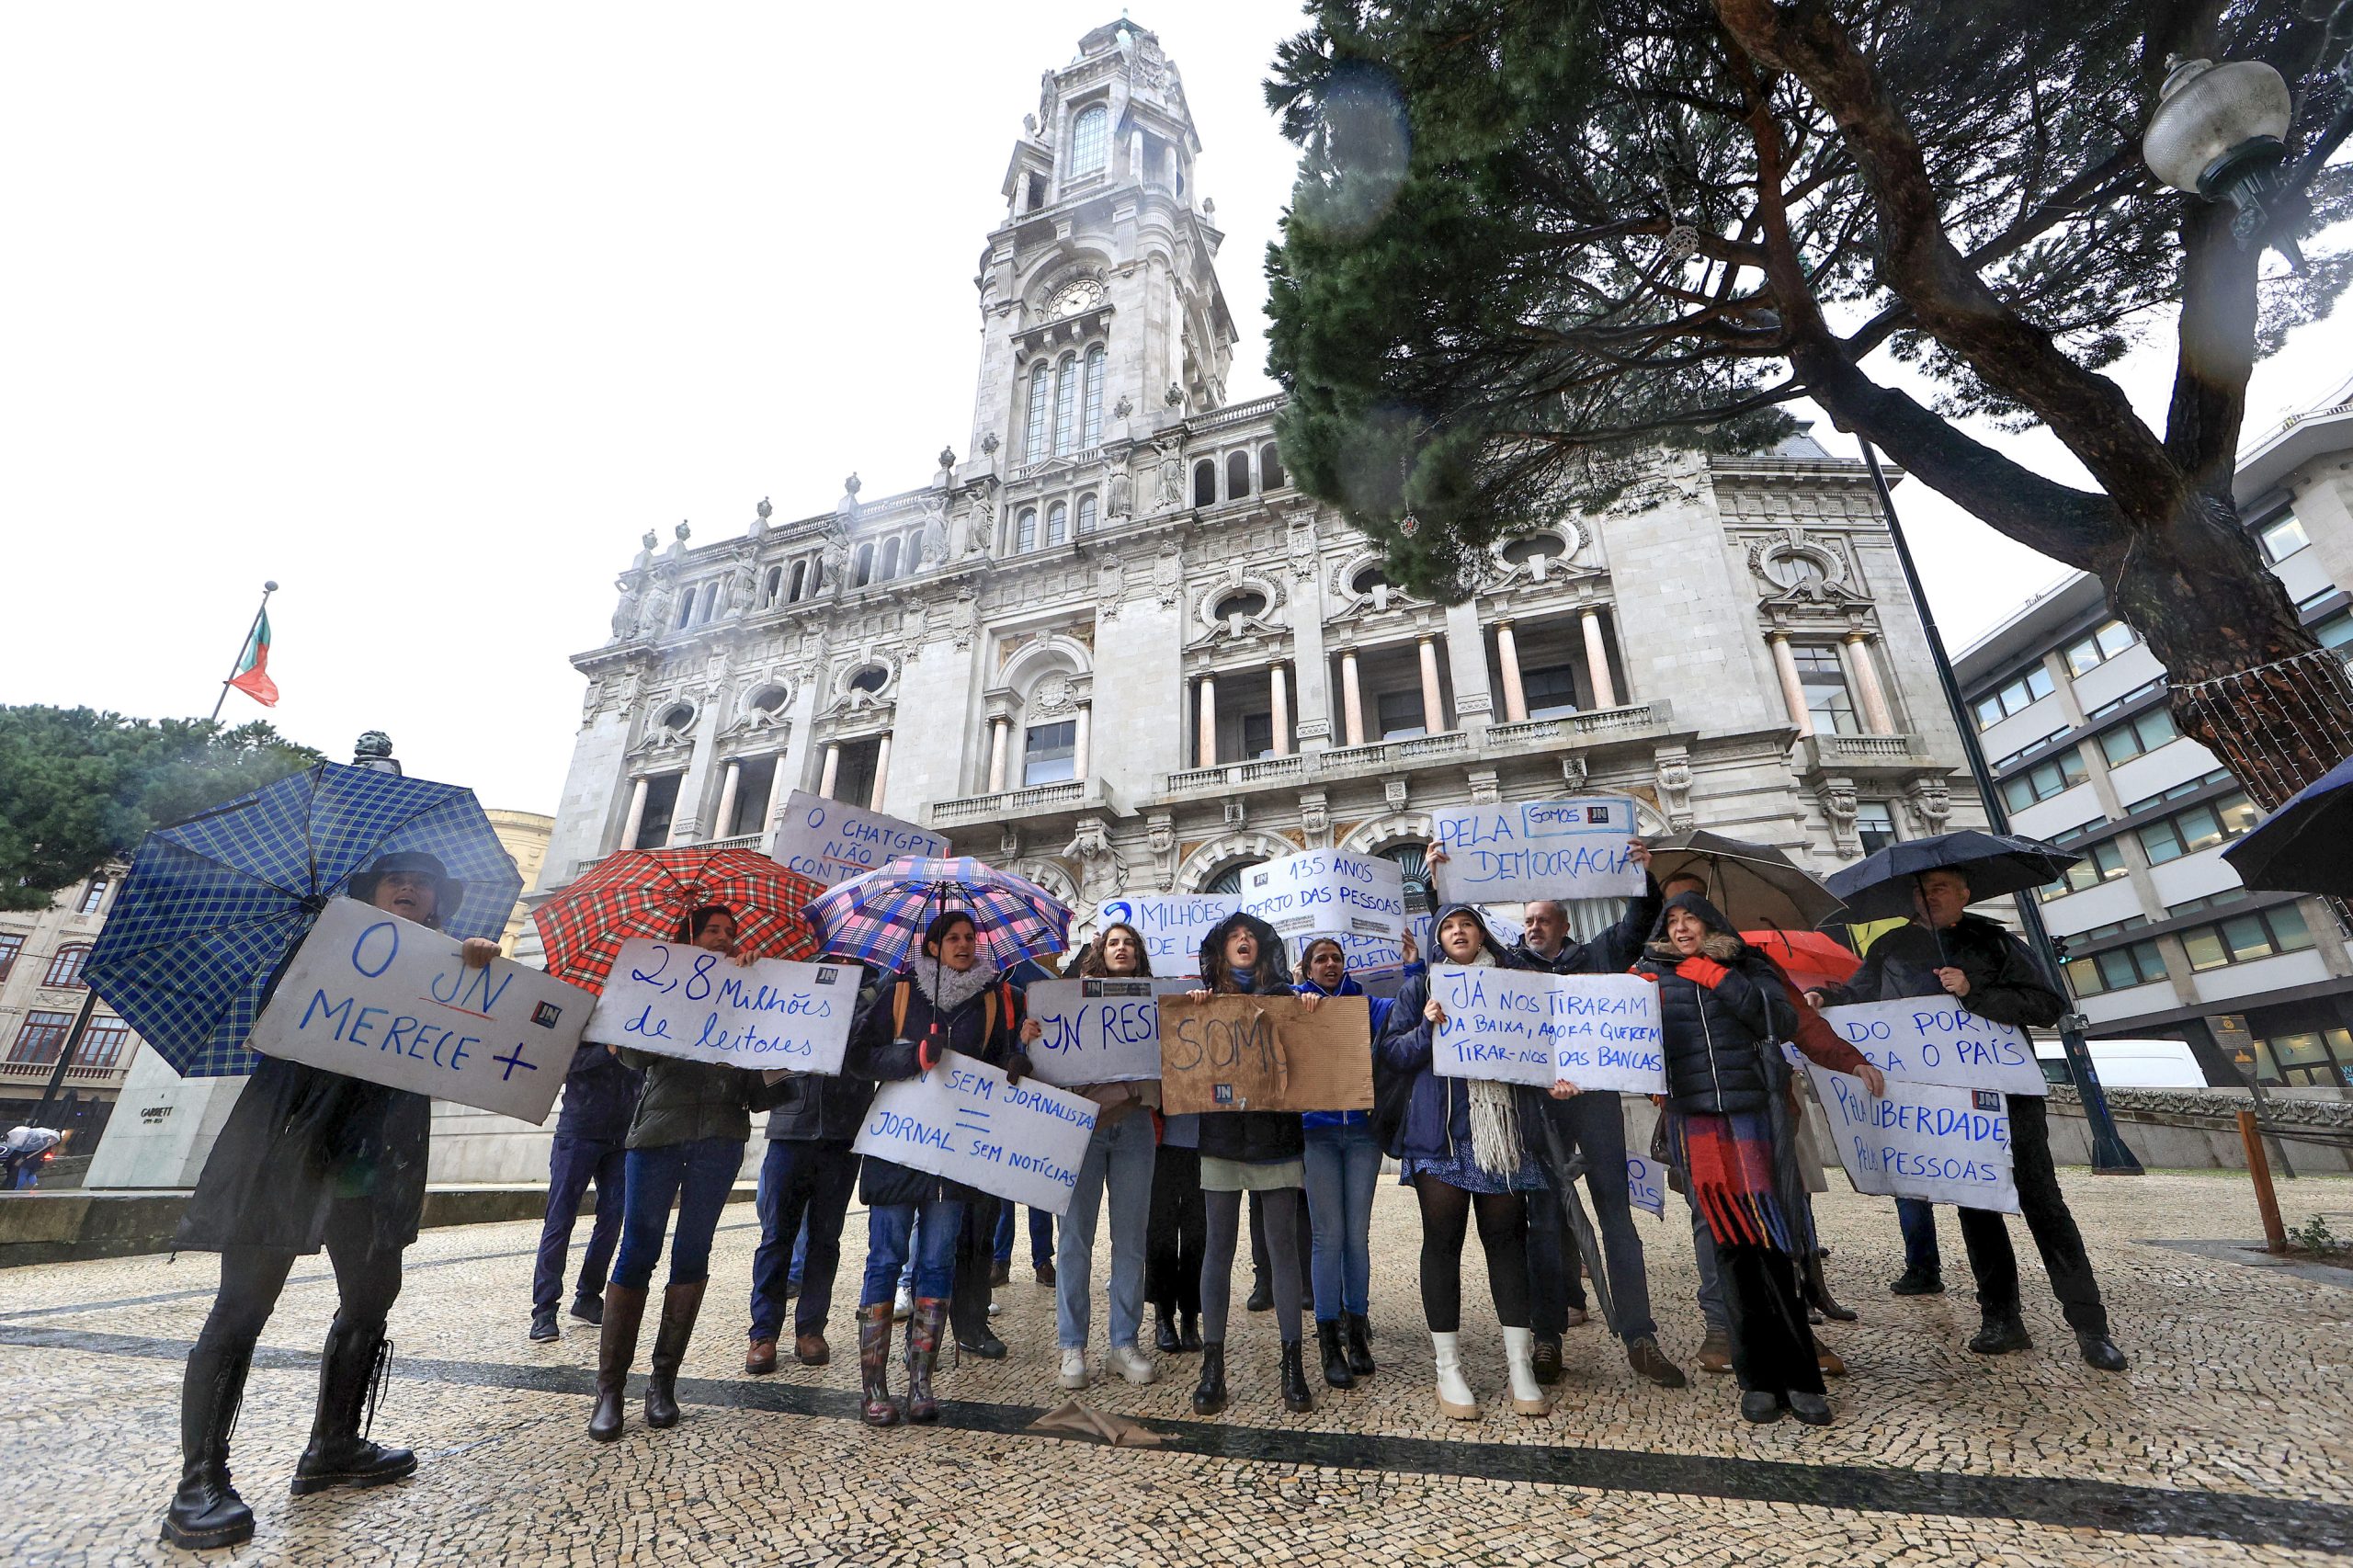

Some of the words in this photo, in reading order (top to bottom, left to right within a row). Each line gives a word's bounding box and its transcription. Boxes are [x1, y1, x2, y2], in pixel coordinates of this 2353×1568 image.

[1529, 806, 1580, 824] SOMOS
[1592, 807, 1608, 820] JN
[807, 807, 825, 828] O
[842, 819, 938, 857] CHATGPT
[1439, 814, 1515, 855] PELA
[823, 840, 872, 865] NÃO
[1289, 857, 1326, 881] 135
[1333, 856, 1373, 883] ANOS
[1463, 845, 1641, 882] DEMOCRACIA
[1141, 898, 1226, 932] MILHÕES
[1245, 893, 1293, 918] PERTO
[1300, 886, 1332, 908] DAS
[1339, 886, 1402, 915] PESSOAS
[1148, 936, 1176, 957] DE
[352, 921, 400, 979] O
[430, 952, 514, 1014] JN
[631, 945, 717, 1001] 2,8
[715, 978, 832, 1017] Milhões
[1442, 970, 1487, 1009] JÁ
[1500, 989, 1540, 1013] NOS
[299, 988, 482, 1071] MERECE
[624, 1005, 673, 1040] de
[694, 1012, 813, 1056] leitores
[1041, 1004, 1089, 1056] JN
[1439, 1014, 1465, 1037] DA
[1472, 1014, 1532, 1040] BAIXA,
[1599, 1022, 1664, 1044] QUEREM
[1847, 1021, 1891, 1043] DO
[1559, 1050, 1590, 1067] DAS
[1597, 1046, 1663, 1071] BANCAS
[1922, 1043, 1940, 1067] O
[1955, 1038, 2026, 1066] PAÍS
[944, 1069, 994, 1100] SEM
[1004, 1085, 1097, 1131] JORNALISTAS
[1977, 1092, 1998, 1108] JN
[870, 1110, 955, 1153] JORNAL
[970, 1140, 1003, 1163] SEM
[1007, 1153, 1078, 1188] NOTÍCIAS
[1881, 1146, 1998, 1182] PESSOAS
